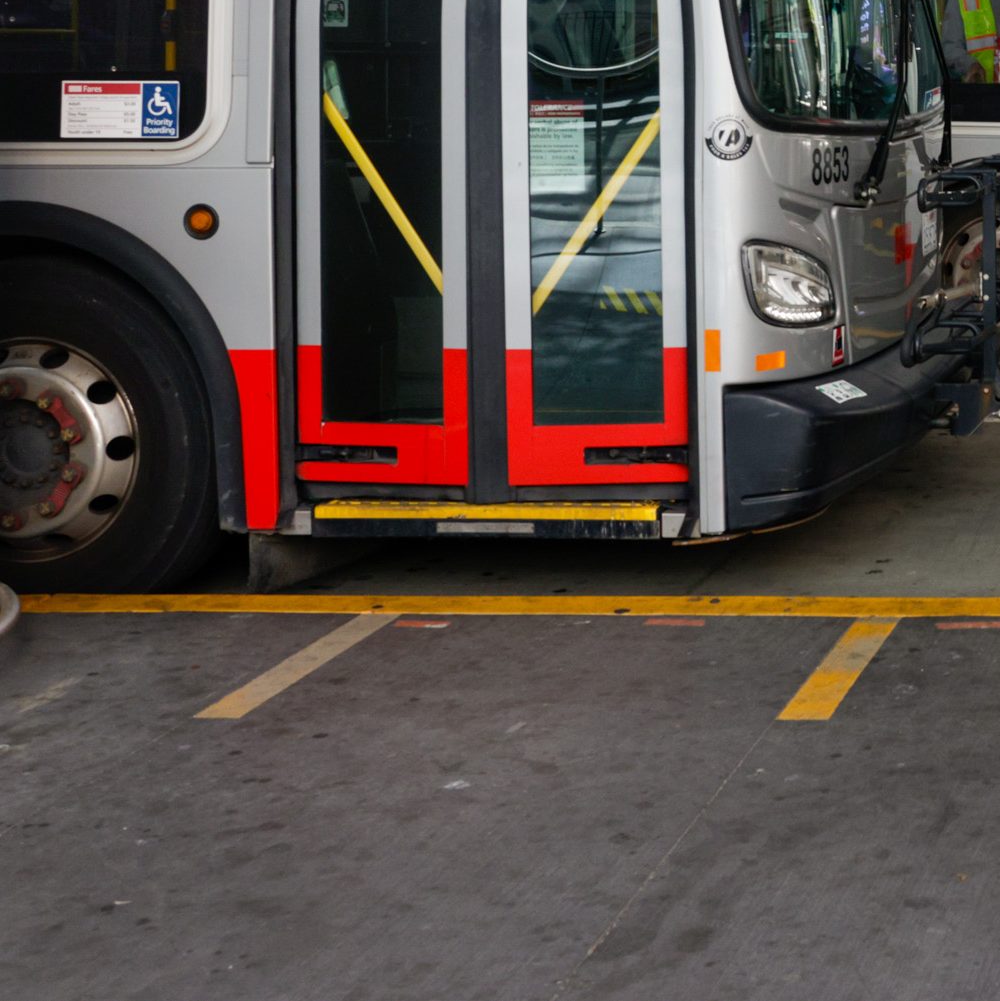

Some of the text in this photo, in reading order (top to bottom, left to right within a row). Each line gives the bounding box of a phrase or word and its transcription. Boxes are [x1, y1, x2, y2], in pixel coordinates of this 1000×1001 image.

[83, 85, 103, 93] Fares
[146, 118, 174, 127] Priority
[143, 126, 176, 136] Boarding
[811, 145, 849, 186] 8853
